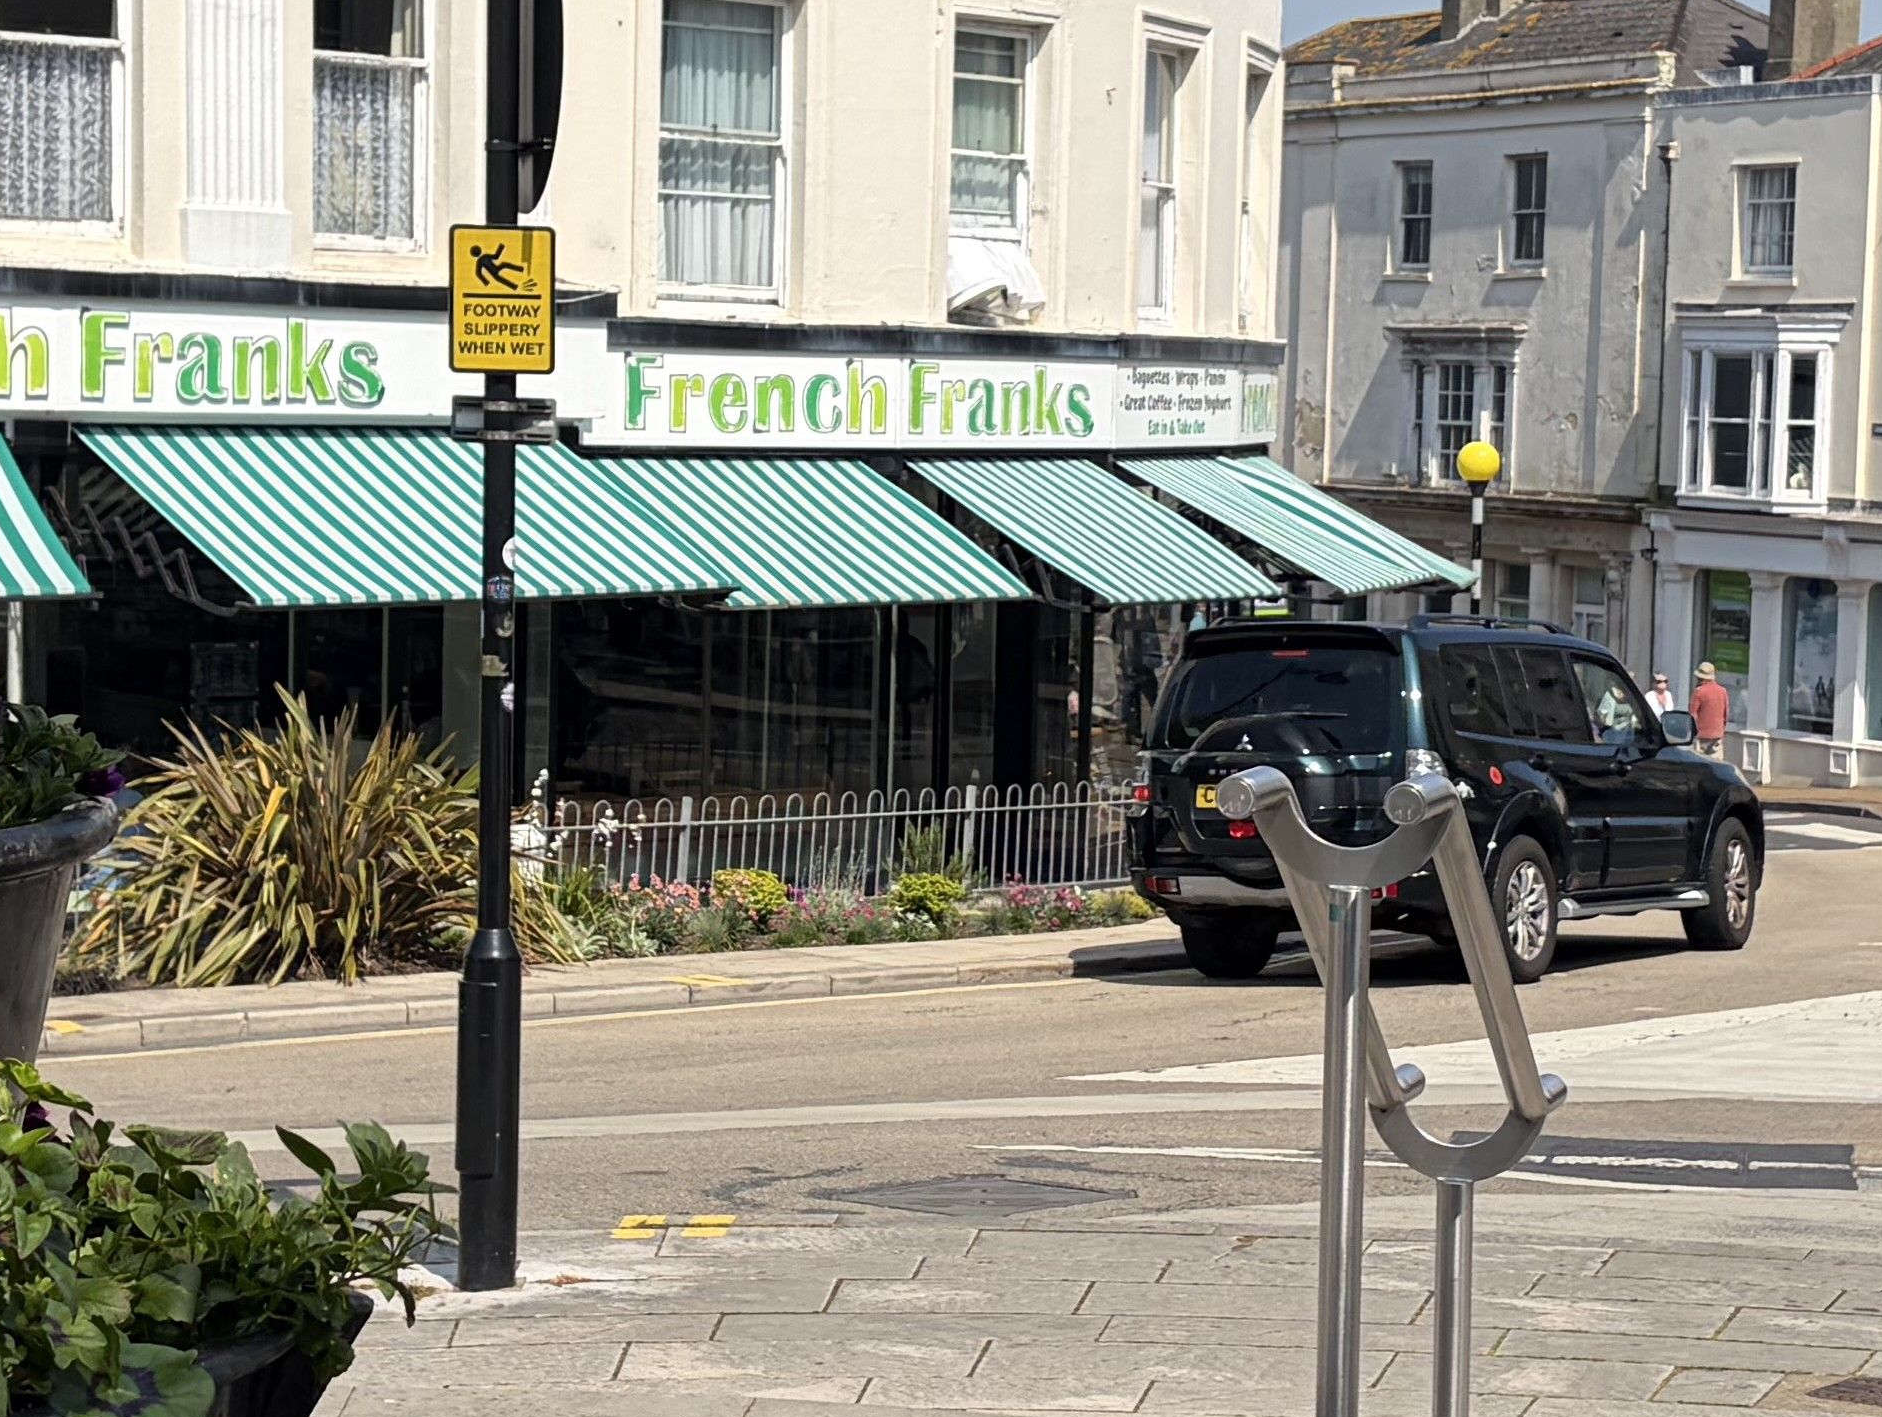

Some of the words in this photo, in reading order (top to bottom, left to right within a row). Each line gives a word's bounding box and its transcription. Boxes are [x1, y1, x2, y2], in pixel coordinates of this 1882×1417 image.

[463, 303, 541, 318] FOOTWAY
[463, 322, 541, 337] SLIPPERY
[458, 340, 506, 355] WHEN
[510, 341, 546, 356] WET
[80, 306, 385, 409] Franks
[1131, 367, 1170, 389] Baguettes
[1175, 369, 1199, 390] Wraps
[624, 350, 888, 435] French
[908, 357, 1095, 439] Franks
[1124, 394, 1147, 411] Great
[1148, 394, 1173, 411] Coffee
[1178, 394, 1203, 412] Frozen
